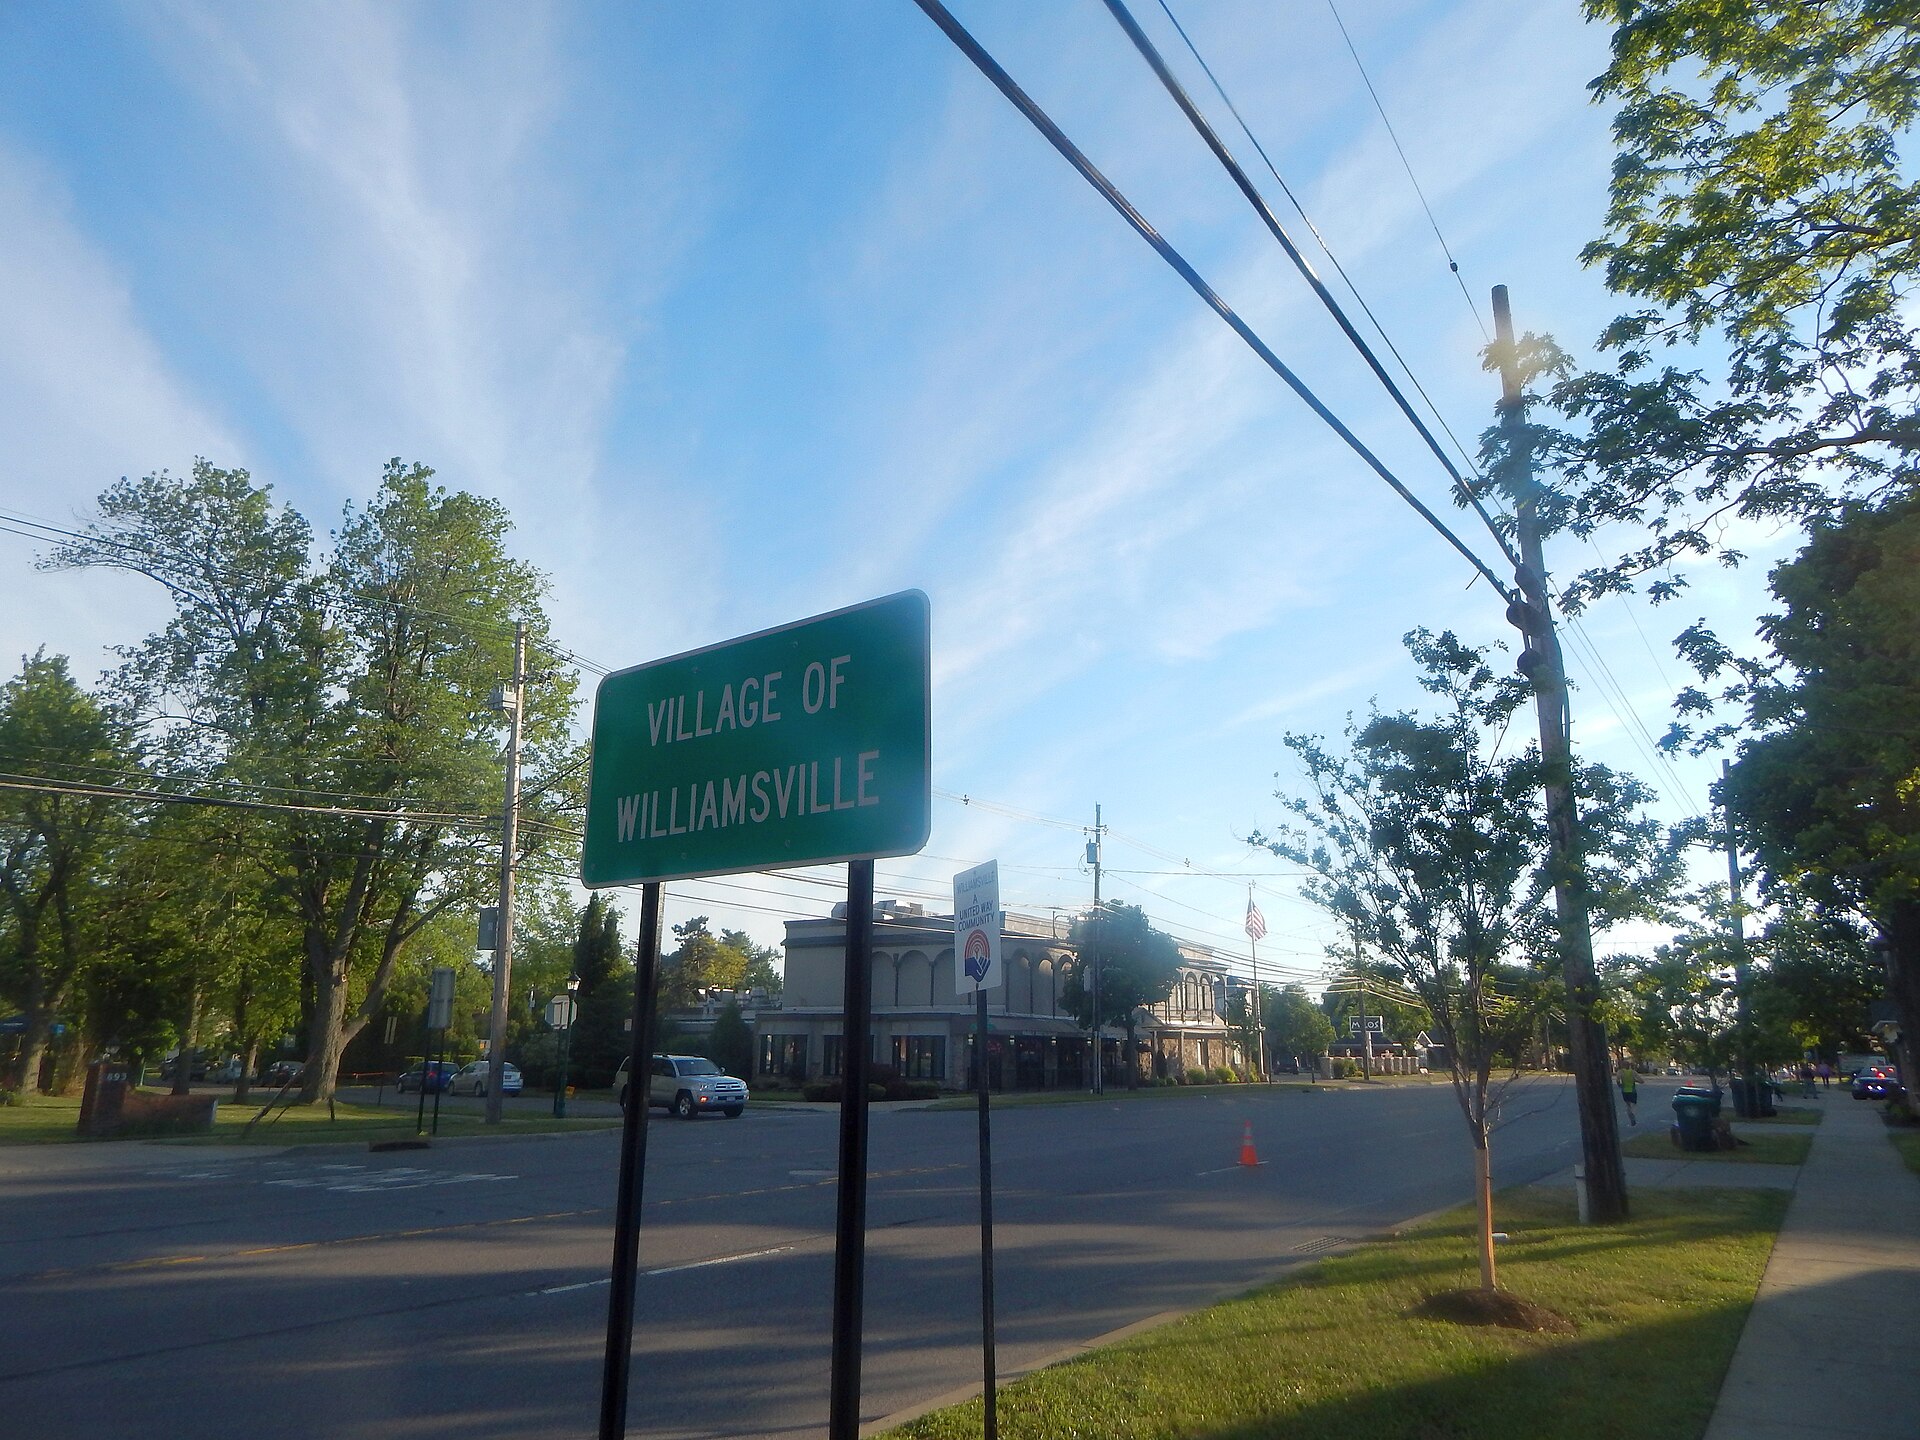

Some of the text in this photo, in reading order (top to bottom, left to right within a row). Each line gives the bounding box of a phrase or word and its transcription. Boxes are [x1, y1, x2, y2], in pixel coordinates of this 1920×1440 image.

[648, 654, 851, 747] VILLAGE OF
[617, 750, 880, 843] WILLIAMSVILLE
[956, 871, 995, 894] WILLIAMSVILLE
[959, 899, 994, 920] UNITED WAY
[972, 894, 978, 905] A
[958, 911, 995, 931] COMMUNITY
[1352, 1020, 1379, 1029] MOS
